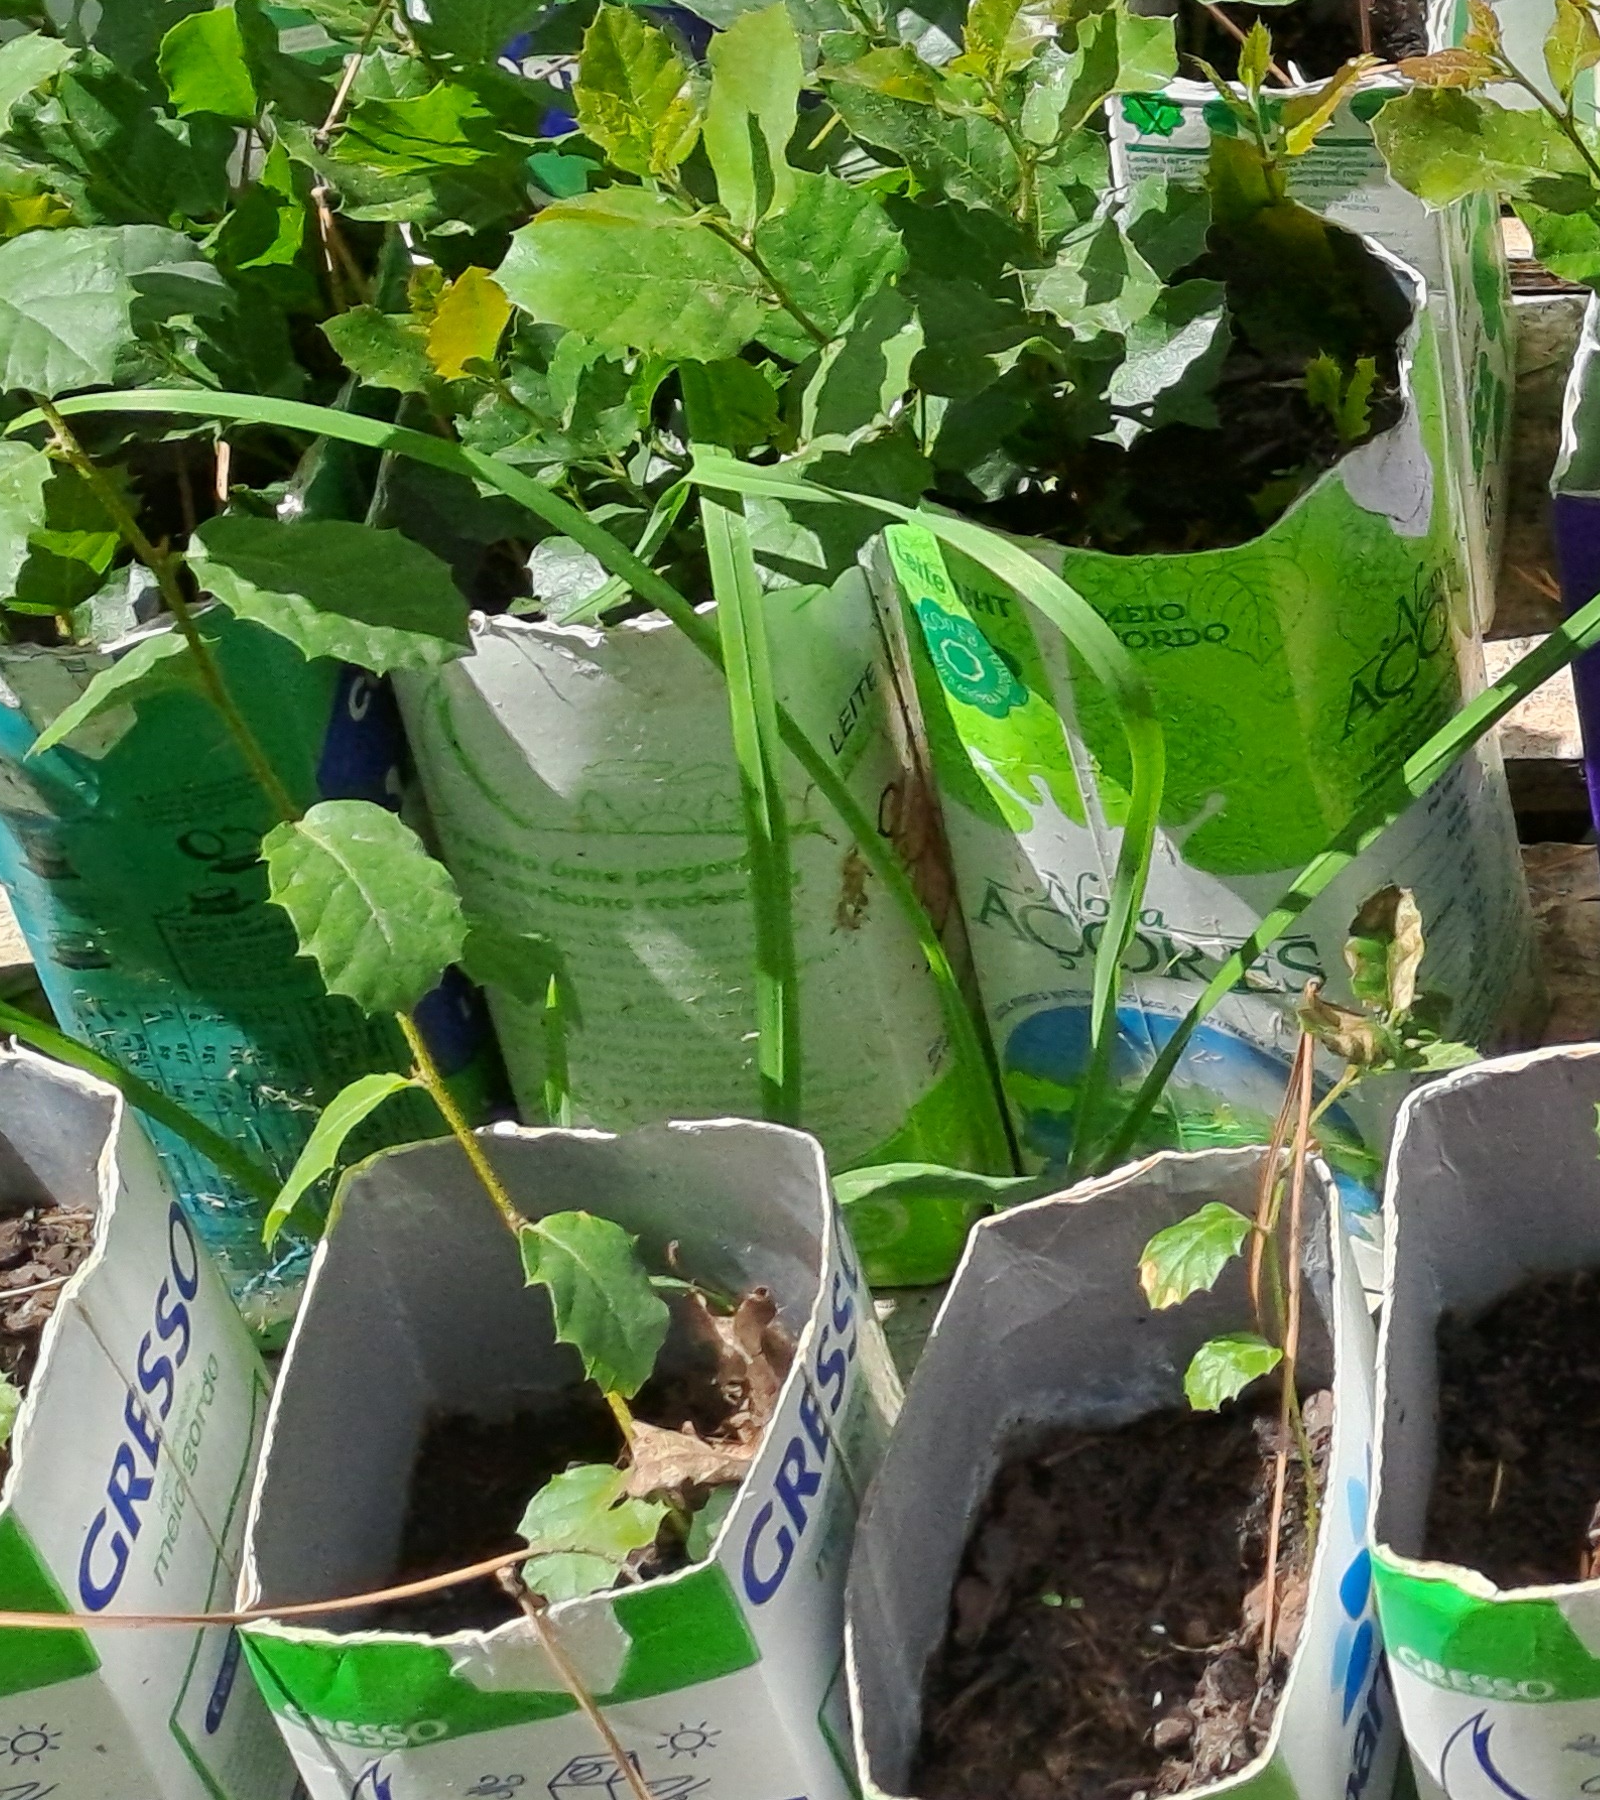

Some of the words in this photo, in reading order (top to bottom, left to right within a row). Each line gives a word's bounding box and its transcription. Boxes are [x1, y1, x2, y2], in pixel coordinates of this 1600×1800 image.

[1122, 622, 1230, 648] ORDO
[829, 661, 879, 758] LEITE
[77, 1202, 202, 1614] GRESSO
[150, 1352, 220, 1589] meio-gordo
[1398, 1646, 1555, 1699] GRESSO
